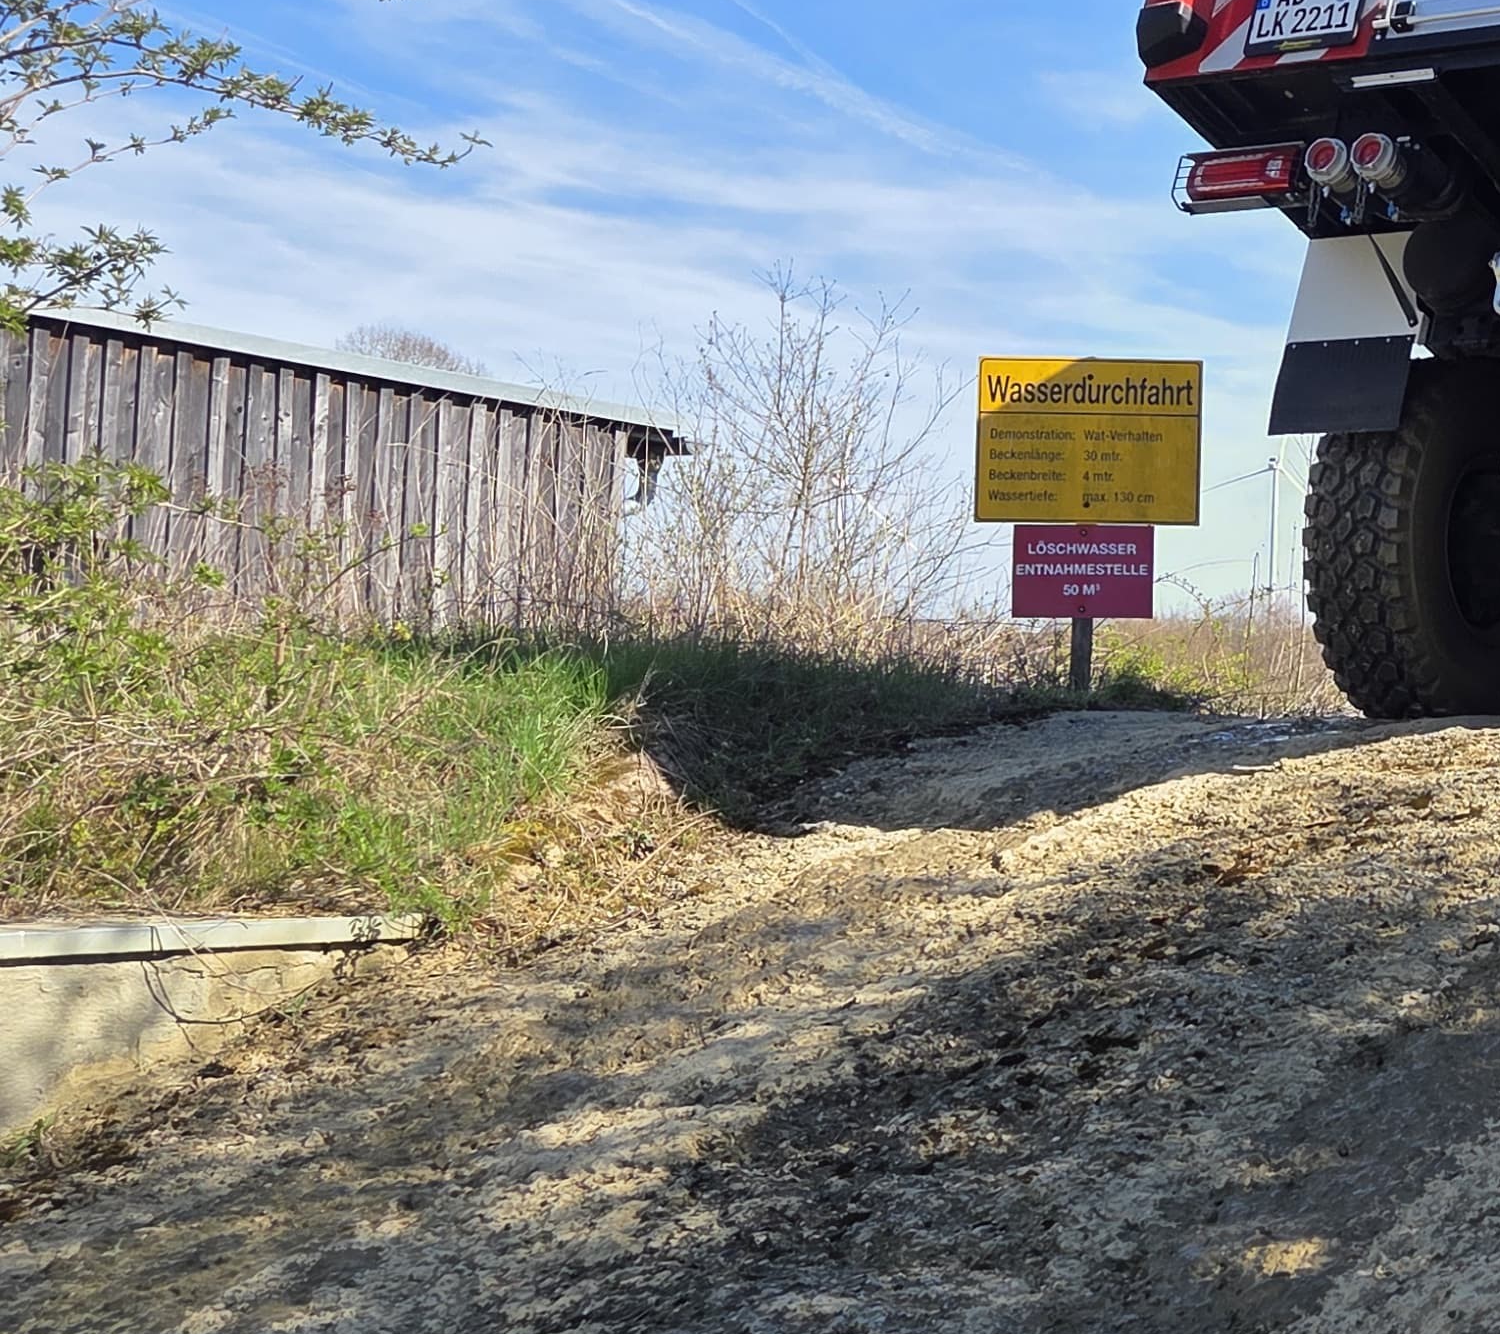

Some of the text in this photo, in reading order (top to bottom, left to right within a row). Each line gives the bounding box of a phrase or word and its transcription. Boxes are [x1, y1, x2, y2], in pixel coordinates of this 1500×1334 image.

[1256, 2, 1350, 39] LK 2211
[987, 374, 1194, 406] Wasserdurchfahrt
[989, 428, 1163, 442] Demonstration: Wat-Verhalten
[989, 448, 1122, 462] Beckenlänge: 30 mtr.
[988, 469, 1115, 482] Beckenbreite: 4 mtr.
[988, 489, 1155, 503] Wassertiefe: max. 130 cm
[1027, 540, 1137, 555] LÖSCHWASSER
[1016, 564, 1149, 576] ENTNAHMESTELLE
[1063, 584, 1079, 596] 50
